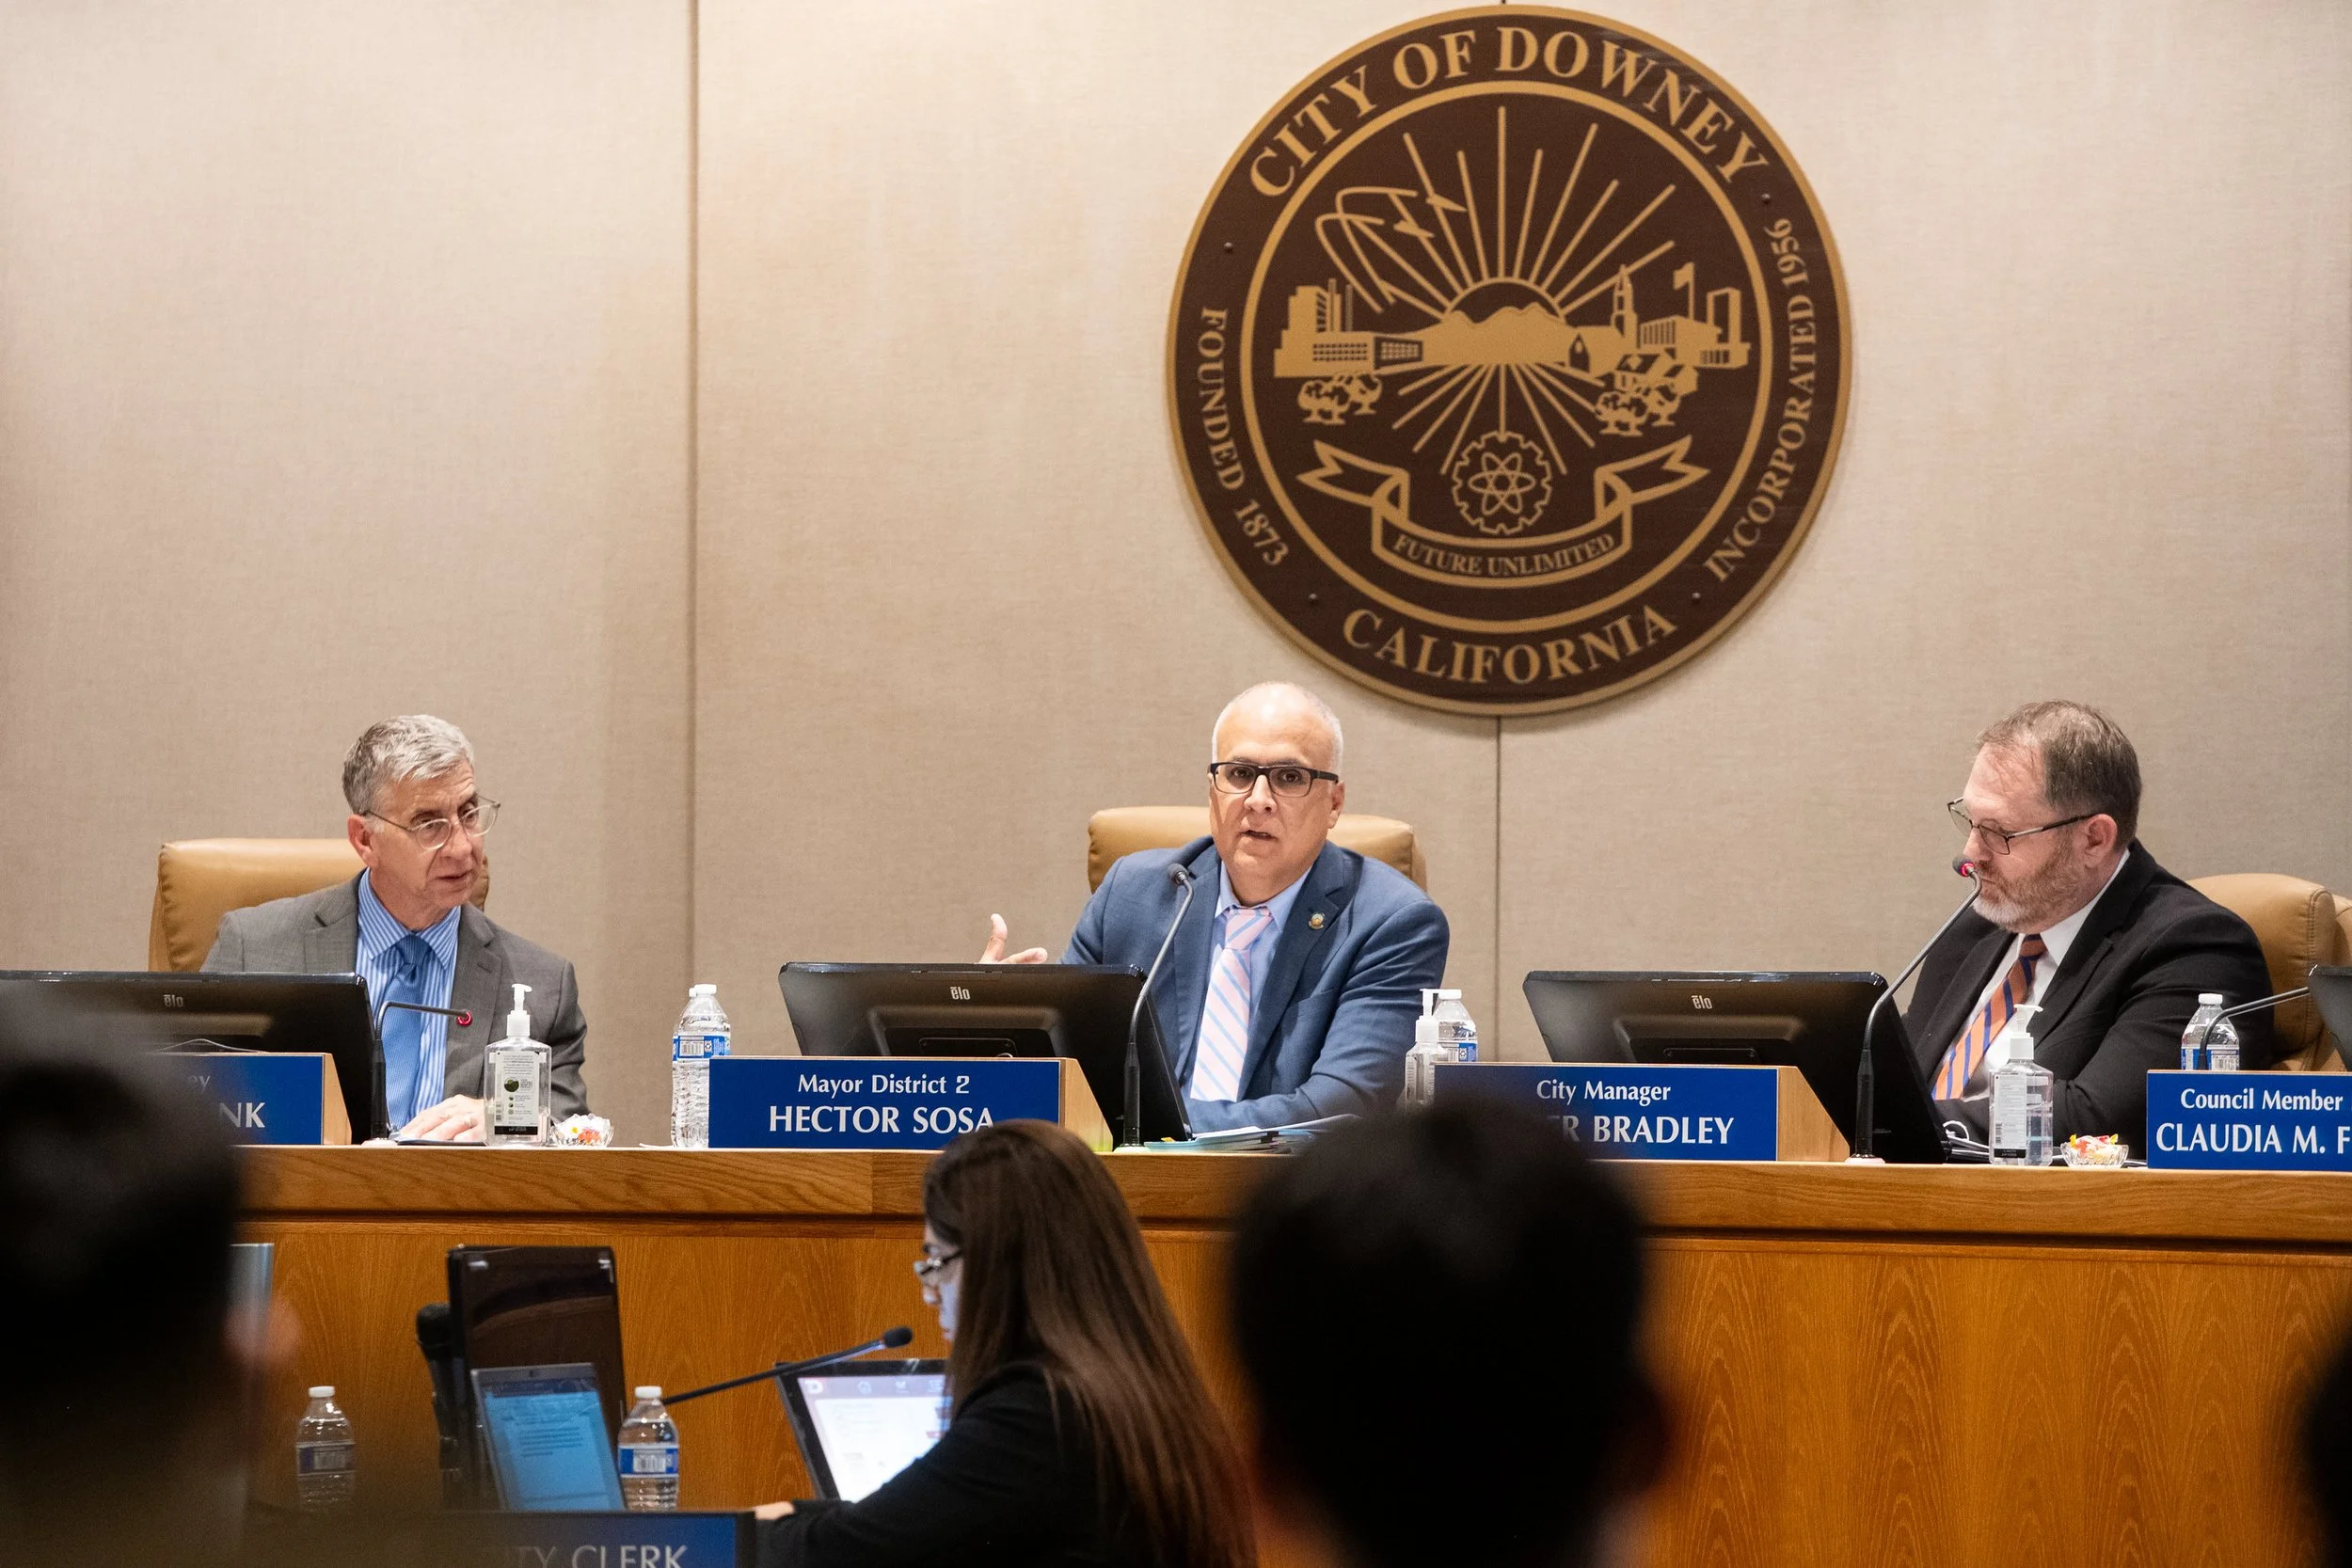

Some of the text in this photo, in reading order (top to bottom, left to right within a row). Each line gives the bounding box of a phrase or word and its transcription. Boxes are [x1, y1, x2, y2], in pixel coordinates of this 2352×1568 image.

[1249, 26, 1770, 197] CITY OF DOWNEY
[1704, 217, 1818, 583] INCORPORATED 1956
[1197, 306, 1290, 566] FOUNDED 1873
[1392, 531, 1616, 578] FUTURE UNLIMITED
[1343, 605, 1677, 684] CALIFORNIA
[798, 1073, 970, 1099] Mayor District 2
[1536, 1079, 1672, 1107] City Manager
[2180, 1087, 2344, 1111] Council Member
[218, 1101, 266, 1129] NK
[769, 1104, 994, 1134] HECTOR SOSA
[1593, 1116, 1735, 1145] BRADLEY
[2155, 1122, 2282, 1153] CLAUDIA
[2292, 1125, 2326, 1154] M.
[571, 1544, 688, 1568] CLERK
